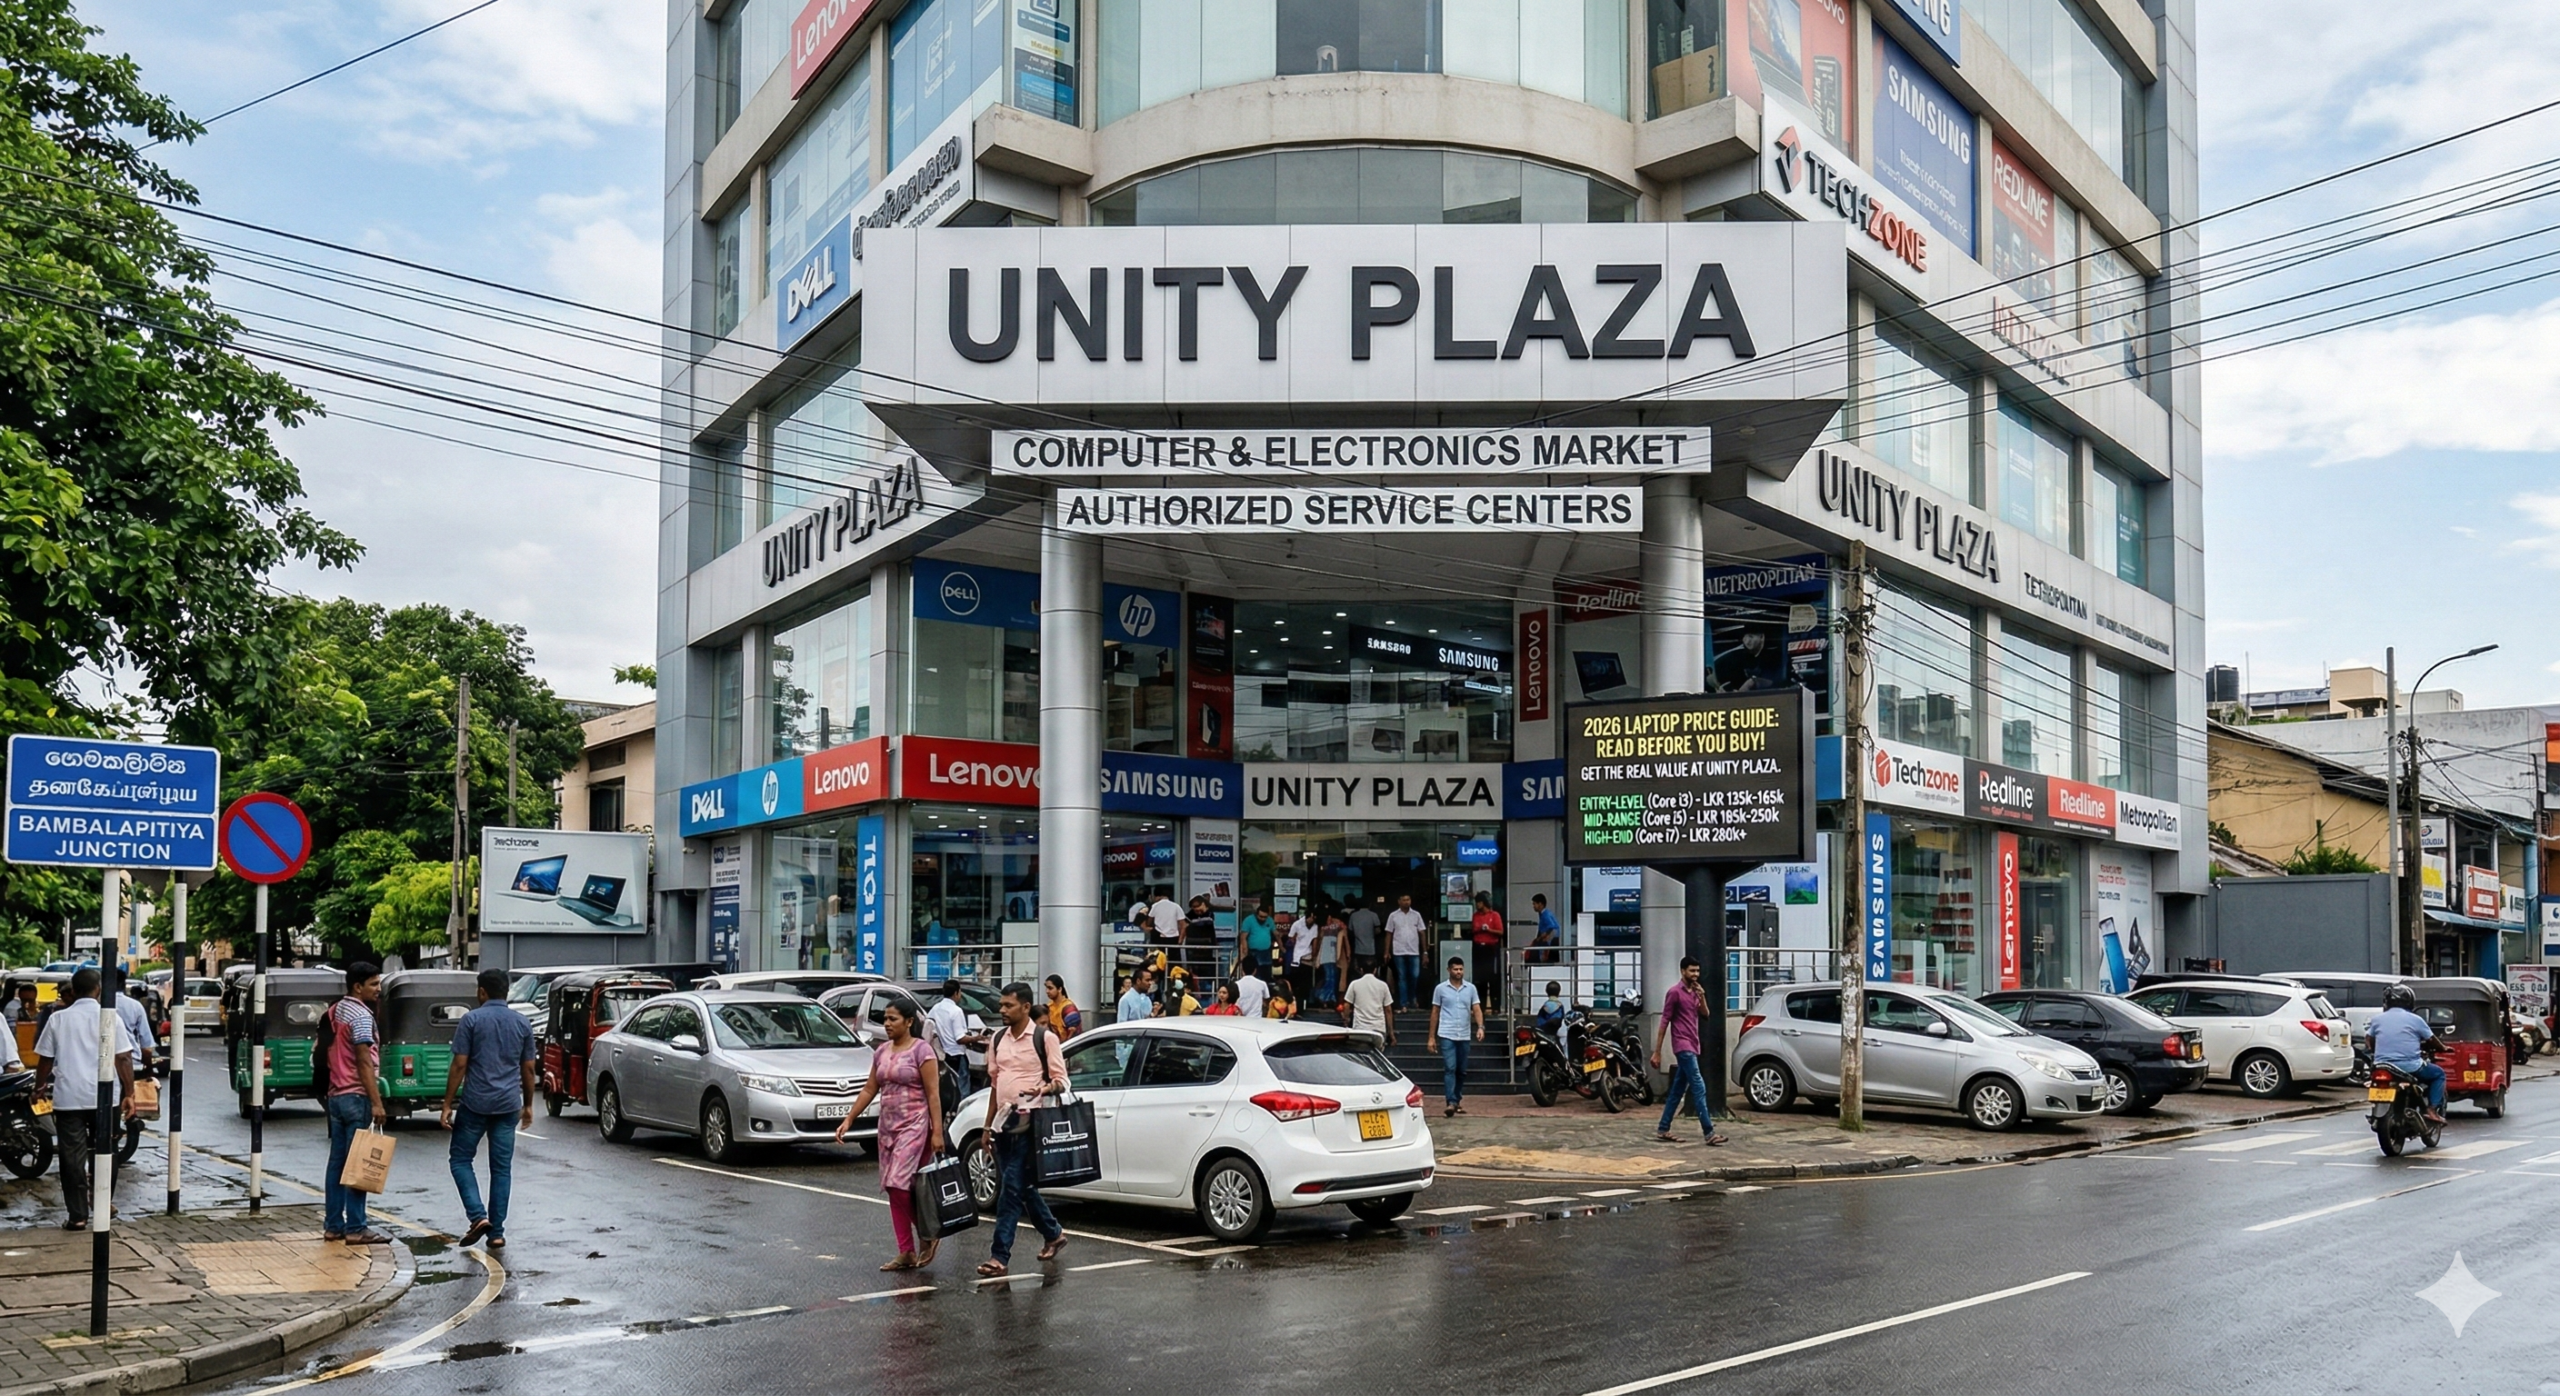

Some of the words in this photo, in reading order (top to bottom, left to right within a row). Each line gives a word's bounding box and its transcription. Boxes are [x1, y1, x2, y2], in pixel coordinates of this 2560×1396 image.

[1888, 65, 1970, 165] SAMSUNG
[1994, 154, 2049, 229] REDLINE
[1804, 149, 1928, 274] TECHZONE
[786, 244, 836, 324] DELL
[948, 265, 1309, 363] UNITY
[1350, 263, 1757, 362] PLAZA
[1012, 436, 1217, 471] COMPUTER
[1228, 437, 1251, 469] &
[1265, 434, 1521, 469] ELECTRONICS
[1533, 433, 1688, 467] MARKET
[762, 505, 831, 588] UNITY
[832, 456, 925, 552] PLAZA
[1066, 496, 1294, 527] AUTHORIZED
[1304, 495, 1456, 526] SERVICE
[1466, 494, 1633, 525] CENTERS
[1818, 448, 1911, 541] UNITY
[1915, 496, 2000, 584] PLAZA
[944, 586, 976, 601] DELL
[1120, 593, 1156, 637] hp
[1438, 647, 1499, 672] SAMSUNG
[1584, 717, 1621, 737] 2026
[1625, 713, 1681, 735] LAPTOP
[1684, 710, 1727, 732] PRICE
[1730, 707, 1780, 729] GUIDE:
[1596, 738, 1634, 758] READ
[1637, 735, 1692, 757] BEFORE
[1696, 733, 1726, 754] YOU
[1729, 731, 1766, 752] BUY!
[814, 762, 870, 795] Lenovo
[929, 752, 1041, 789] Lenov
[1101, 768, 1224, 801] SAMSUNG
[1580, 766, 1602, 781] GET
[1604, 765, 1624, 780] THE
[1626, 763, 1653, 779] REAL
[1655, 762, 1689, 778] VALUE
[1690, 761, 1704, 776] AT
[1706, 760, 1740, 777] UNITY
[1742, 758, 1782, 775] PLAZA.
[1893, 756, 1960, 793] Techzone
[691, 788, 725, 824] DELL
[1251, 776, 1361, 807] UNITY
[1372, 776, 1495, 807] PLAZA
[1579, 794, 1646, 811] ENTRY-LEVEL
[1648, 791, 1677, 809] (Core
[1678, 790, 1693, 808] i3)
[1703, 791, 1724, 807] LKR
[1726, 789, 1785, 807] 135k-165k
[1979, 770, 2034, 809] Redline
[2060, 788, 2106, 819] Redline
[19, 815, 205, 840] BAMBALAPITIYA
[1583, 812, 1641, 828] MID-RANGE
[1643, 810, 1671, 828] (Core
[1673, 808, 1688, 827] i5)
[1697, 809, 1718, 825] LKR
[1720, 807, 1780, 824] 185k-250k
[55, 839, 171, 861] JUNCTION
[1461, 846, 1498, 856] Lenovo
[1584, 829, 1633, 845] HIGH-END
[1635, 827, 1664, 846] (Core
[1665, 827, 1680, 845] i7)
[1689, 826, 1710, 843] LKR
[1712, 826, 1748, 842] 280k+
